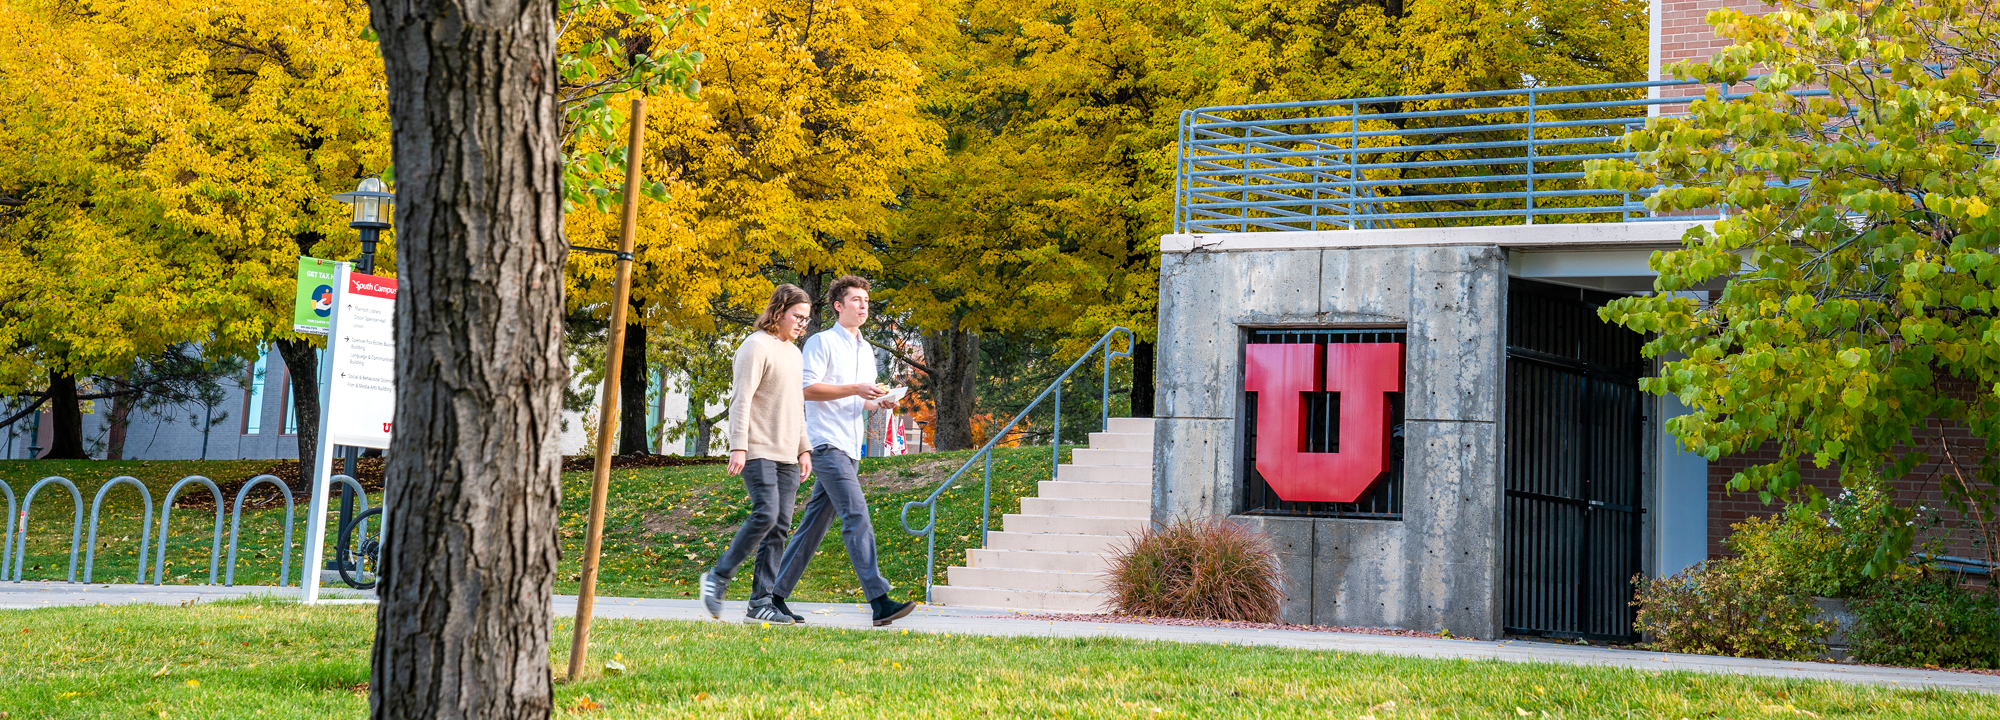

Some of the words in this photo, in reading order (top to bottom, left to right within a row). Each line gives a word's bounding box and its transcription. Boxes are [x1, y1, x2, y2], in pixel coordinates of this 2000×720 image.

[307, 270, 318, 278] GET
[319, 272, 330, 280] TAX
[355, 280, 373, 291] South
[374, 284, 397, 295] Campus
[383, 422, 392, 433] U
[1244, 342, 1406, 503] U
